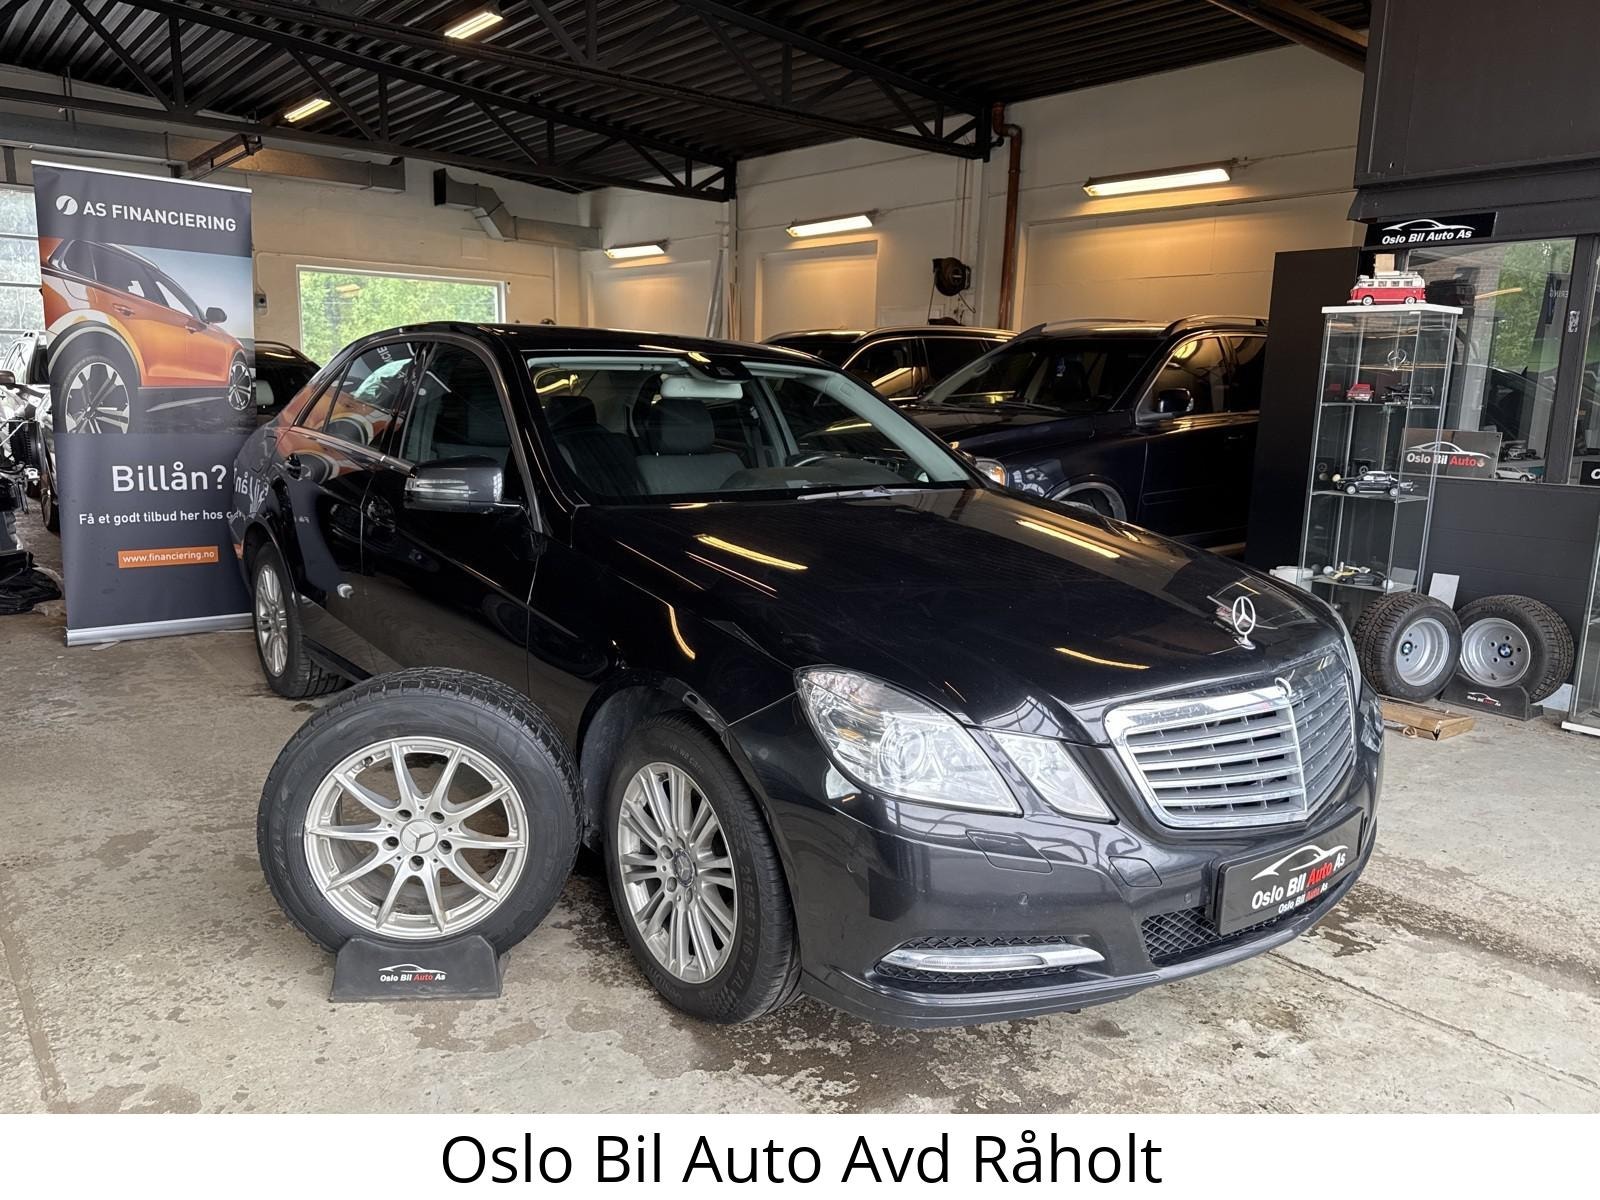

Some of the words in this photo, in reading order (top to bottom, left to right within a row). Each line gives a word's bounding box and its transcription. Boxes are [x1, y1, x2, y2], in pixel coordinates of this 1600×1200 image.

[83, 201, 107, 217] AS
[112, 204, 237, 232] FINANCIERING
[1381, 234, 1406, 245] Oslo
[1408, 232, 1425, 243] Bil
[1426, 230, 1454, 242] Auto
[1456, 229, 1472, 239] As
[1406, 452, 1431, 464] Oslo
[1433, 454, 1448, 465] Bil
[1449, 455, 1476, 467] Auto
[111, 461, 227, 493] Billån?
[79, 512, 95, 525] Få
[98, 513, 111, 524] et
[113, 512, 141, 526] godt
[143, 510, 177, 523] tilbud
[180, 510, 200, 521] her
[202, 509, 223, 520] hos
[122, 551, 215, 563] www.financiering.no
[1252, 885, 1284, 910] Oslo
[1286, 872, 1306, 897] Bil
[1307, 862, 1333, 887] Auto
[1278, 900, 1294, 914] Oslo
[380, 974, 399, 982] Oslo
[400, 973, 413, 982] Bil
[413, 973, 433, 982] Auto
[434, 973, 446, 981] As
